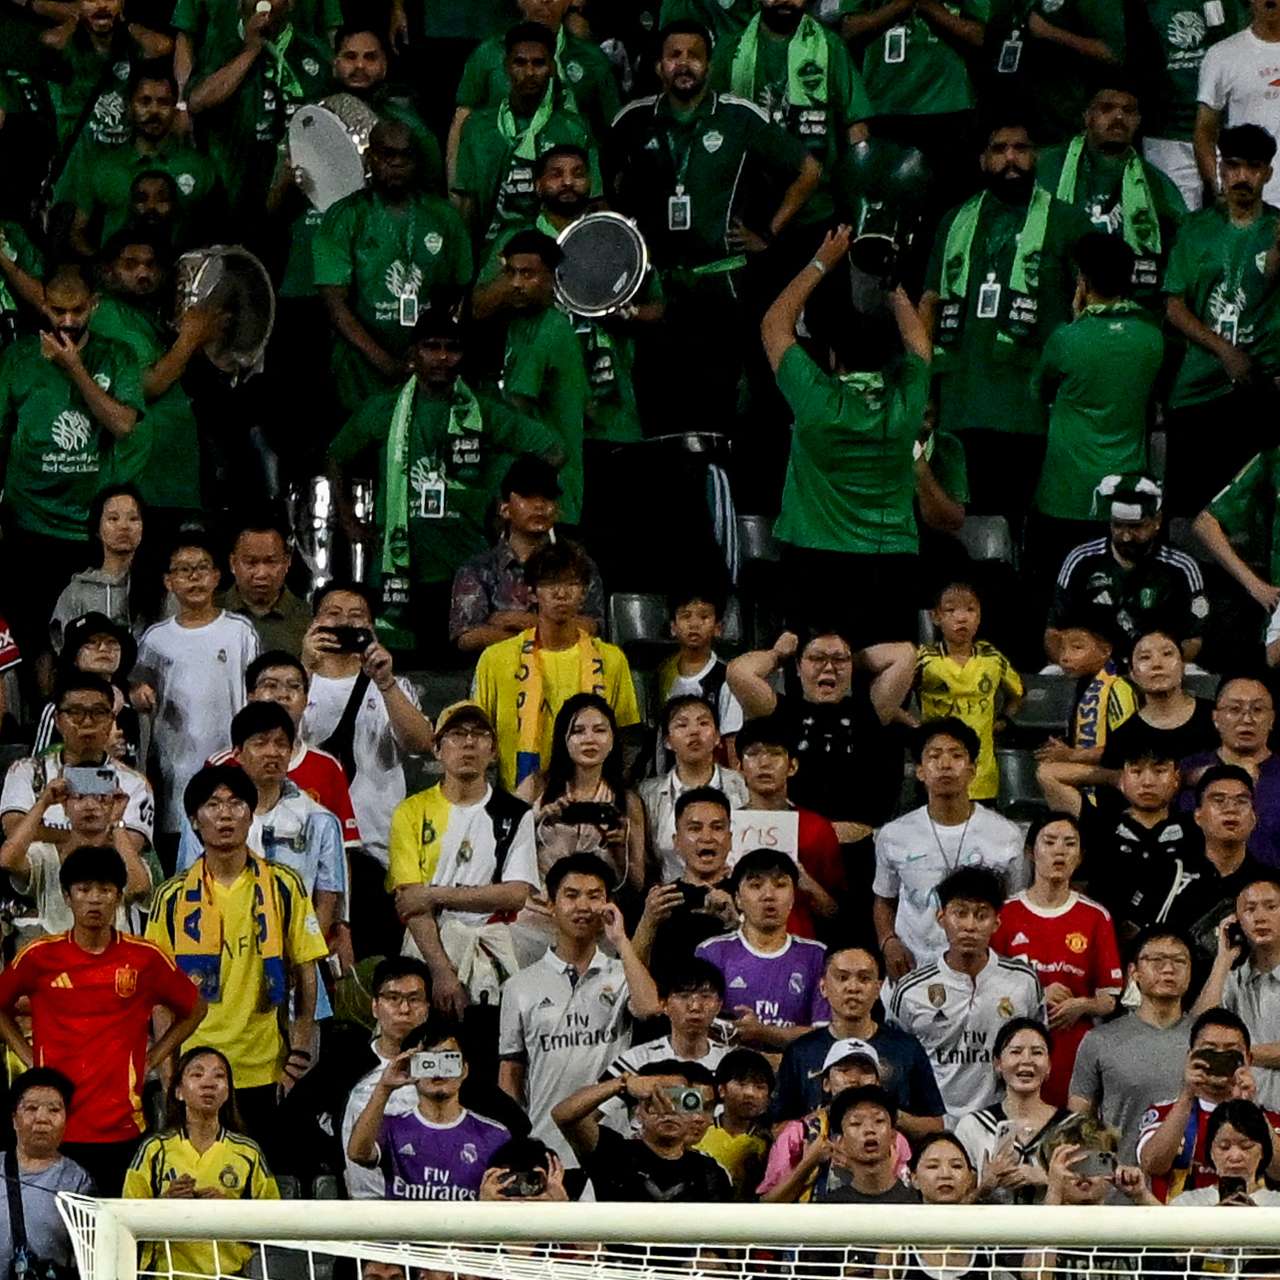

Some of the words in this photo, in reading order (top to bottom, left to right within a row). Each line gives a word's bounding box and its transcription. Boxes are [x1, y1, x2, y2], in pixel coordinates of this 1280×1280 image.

[756, 1000, 780, 1018] Fly
[565, 1014, 590, 1034] Fly
[540, 1027, 630, 1052] Emirates
[964, 1031, 988, 1047] Fly
[936, 1046, 992, 1065] Emira
[424, 1167, 451, 1184] Fly
[393, 1176, 478, 1200] Emirates
